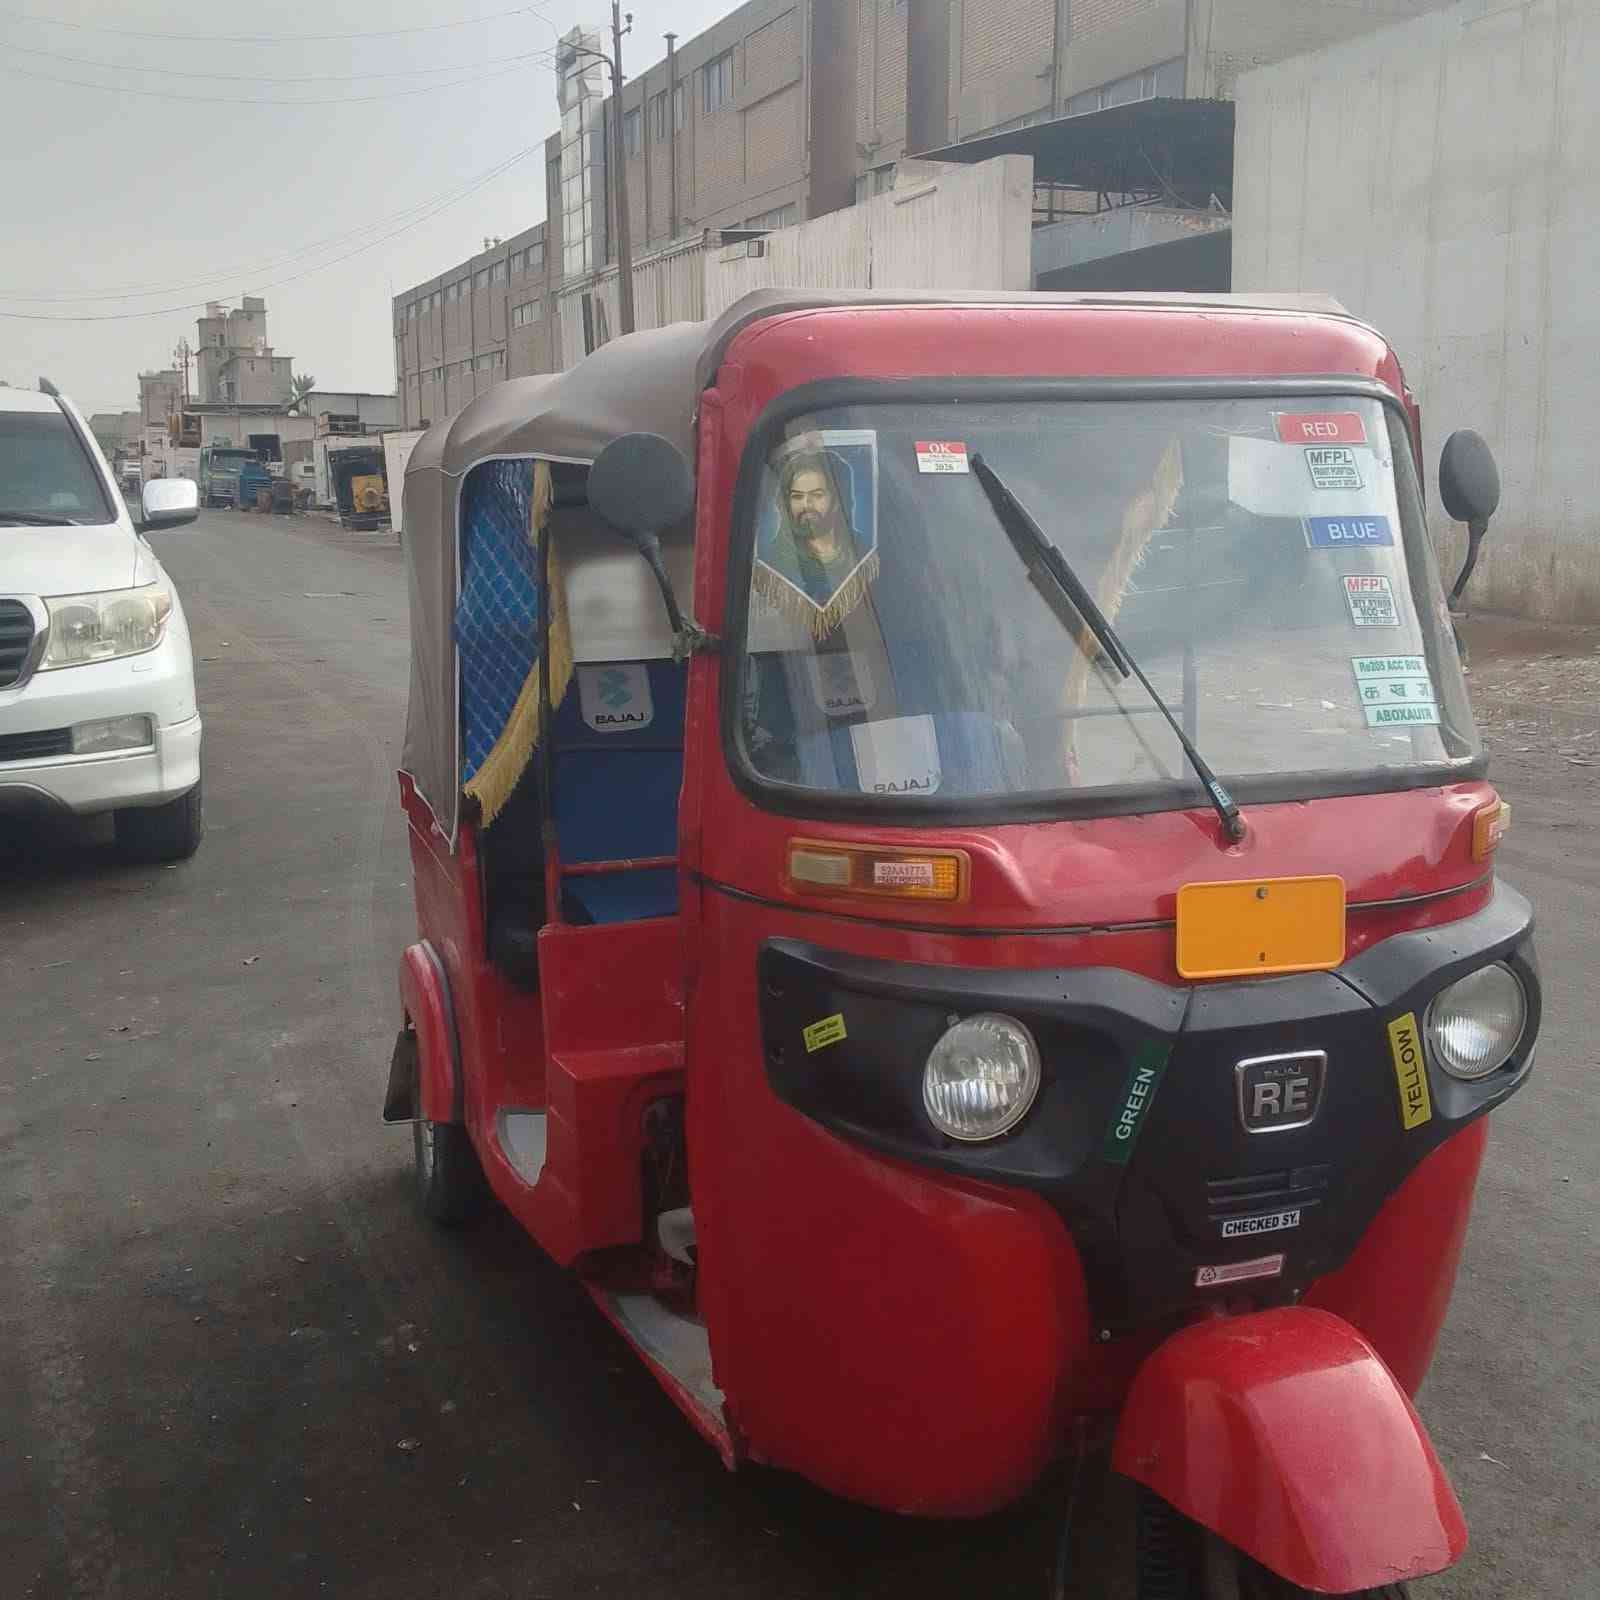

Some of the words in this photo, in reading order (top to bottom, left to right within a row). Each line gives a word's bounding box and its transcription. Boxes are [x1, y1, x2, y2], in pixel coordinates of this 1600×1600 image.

[1302, 422, 1338, 437] RED
[929, 443, 953, 454] OK
[1310, 451, 1353, 464] MFPL
[1327, 523, 1379, 540] BLUE
[1347, 578, 1387, 591] MFPL
[595, 712, 644, 725] BAJAJ
[874, 776, 931, 793] BAJAJ
[1397, 1029, 1423, 1117] YELLOW
[1115, 1067, 1156, 1140] GREEN
[1253, 1077, 1310, 1117] RE
[1225, 1216, 1279, 1235] CHECKED
